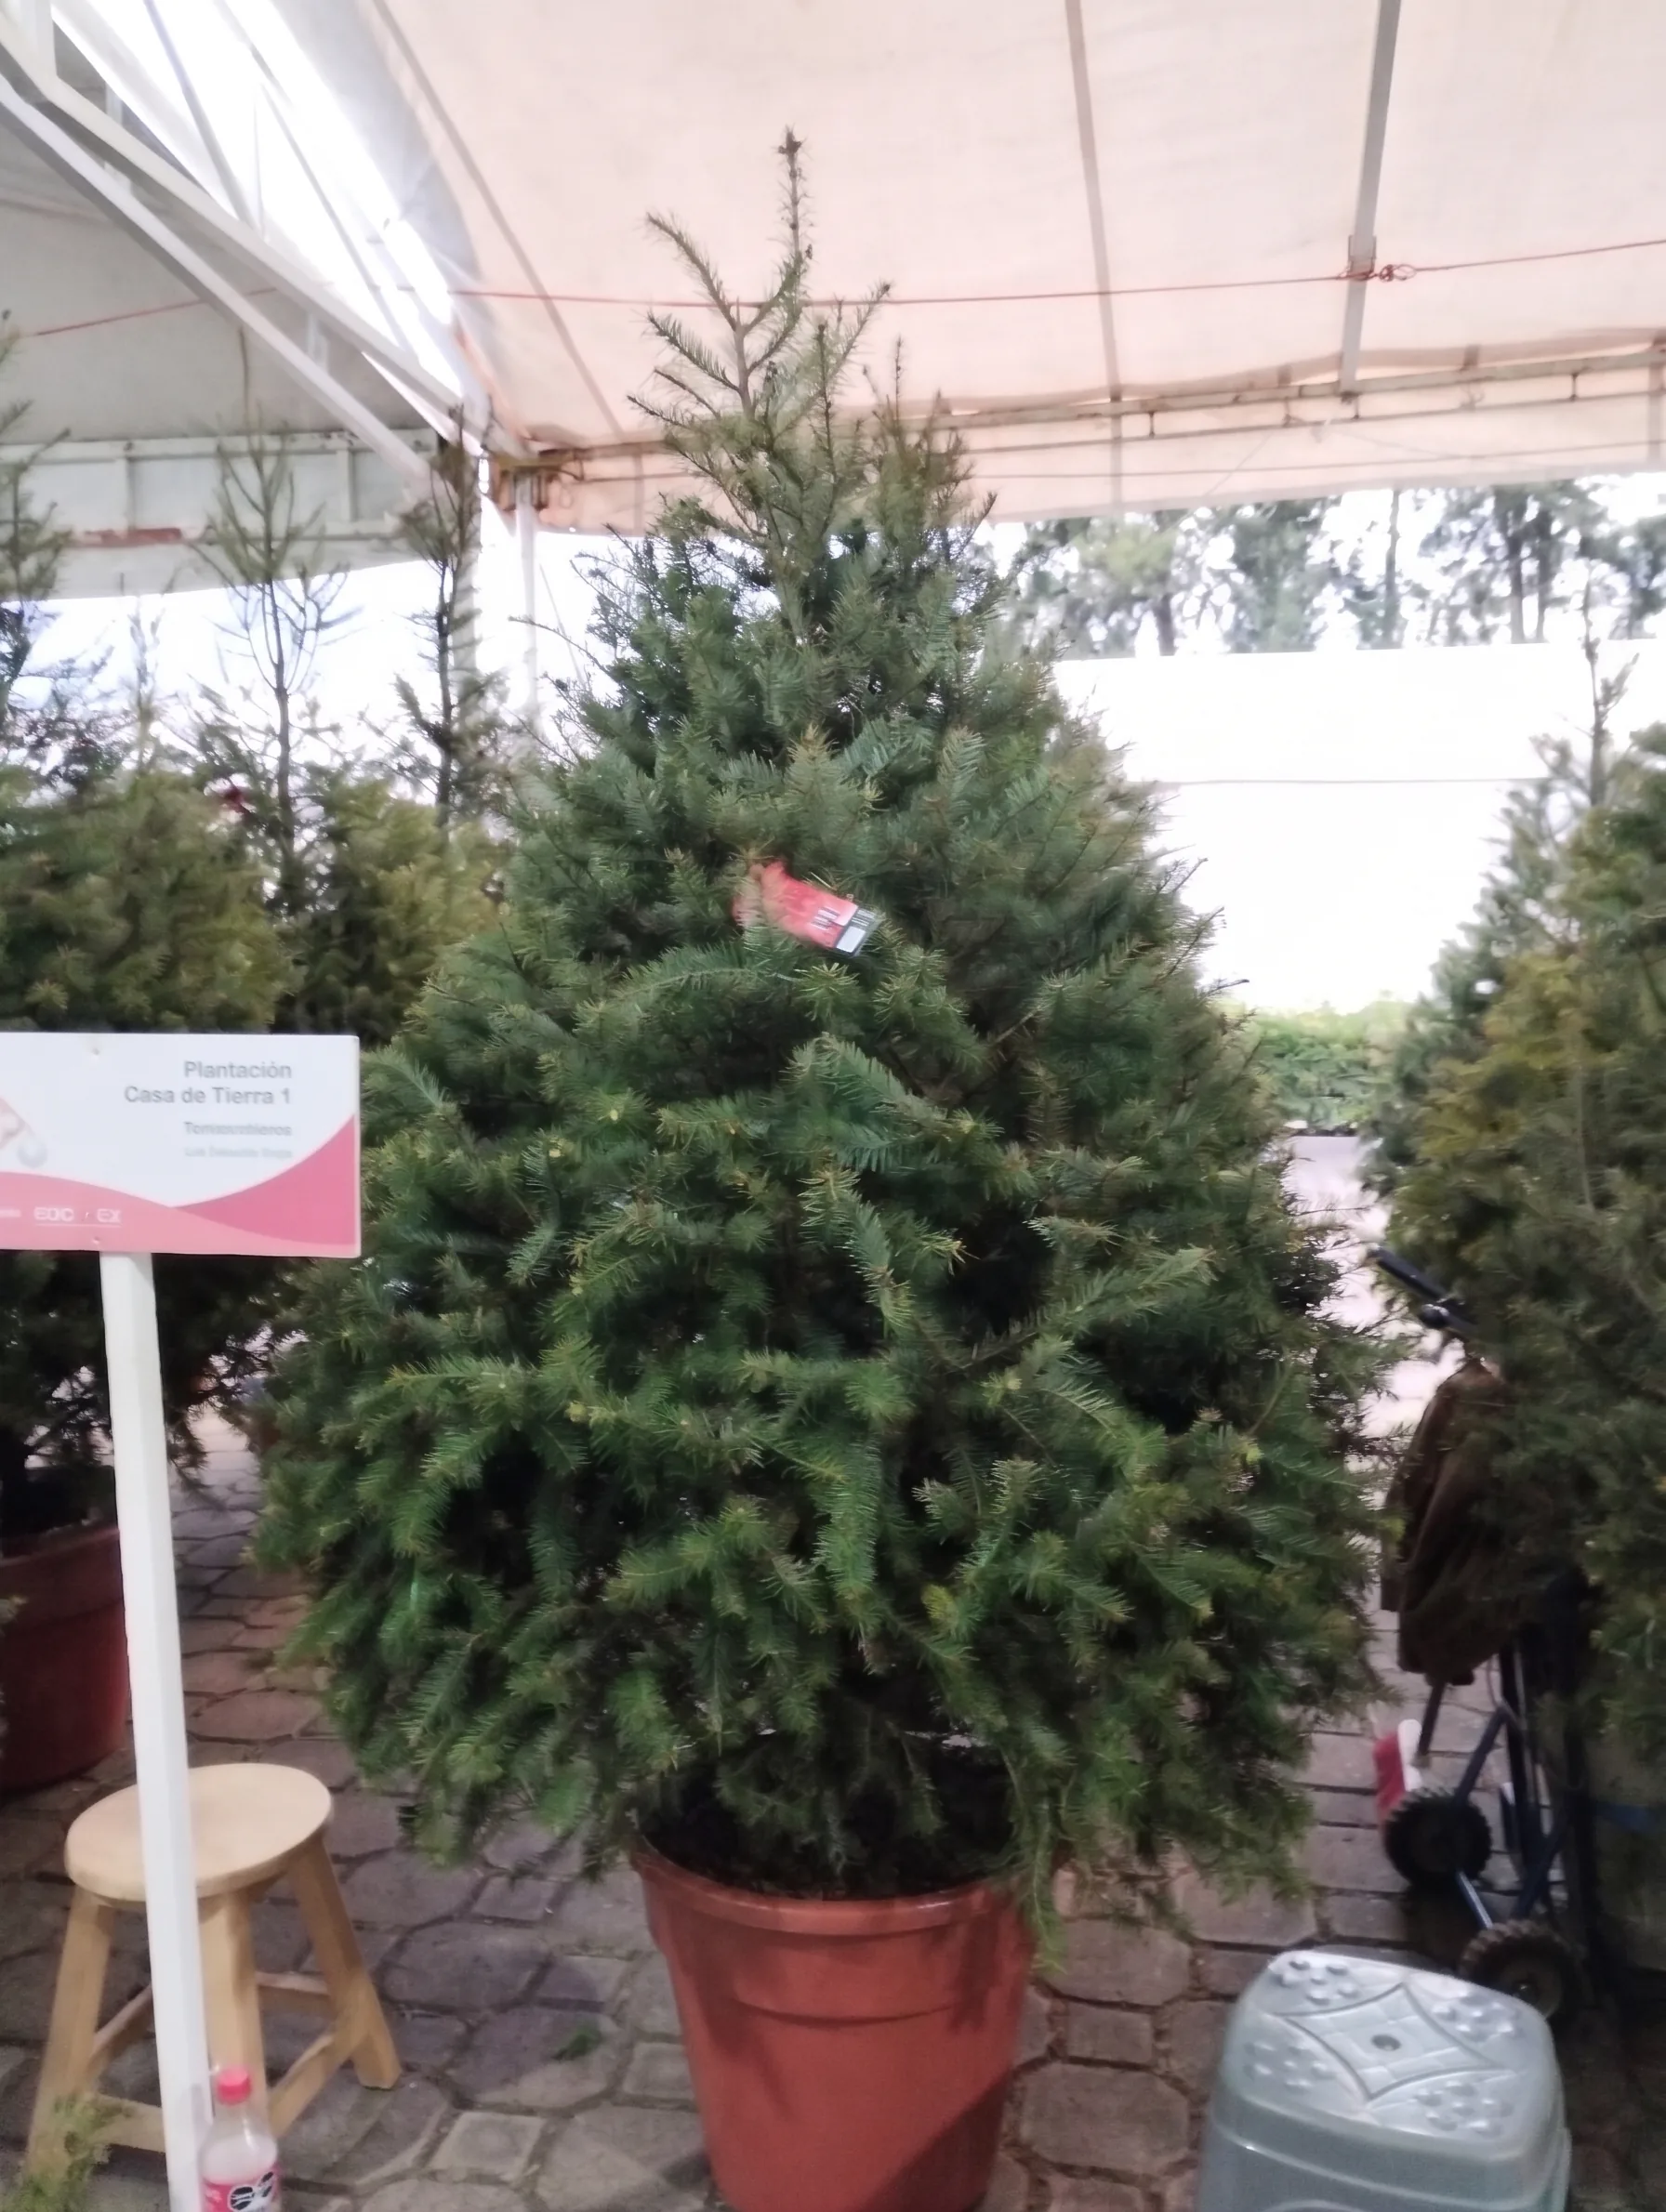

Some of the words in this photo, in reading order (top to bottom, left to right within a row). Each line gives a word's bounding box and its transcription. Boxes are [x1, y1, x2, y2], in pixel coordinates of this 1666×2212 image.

[183, 1060, 292, 1079] Plantación
[124, 1086, 175, 1103] Casa
[181, 1086, 205, 1103] de
[211, 1086, 273, 1104] Tierra
[281, 1087, 291, 1104] 1
